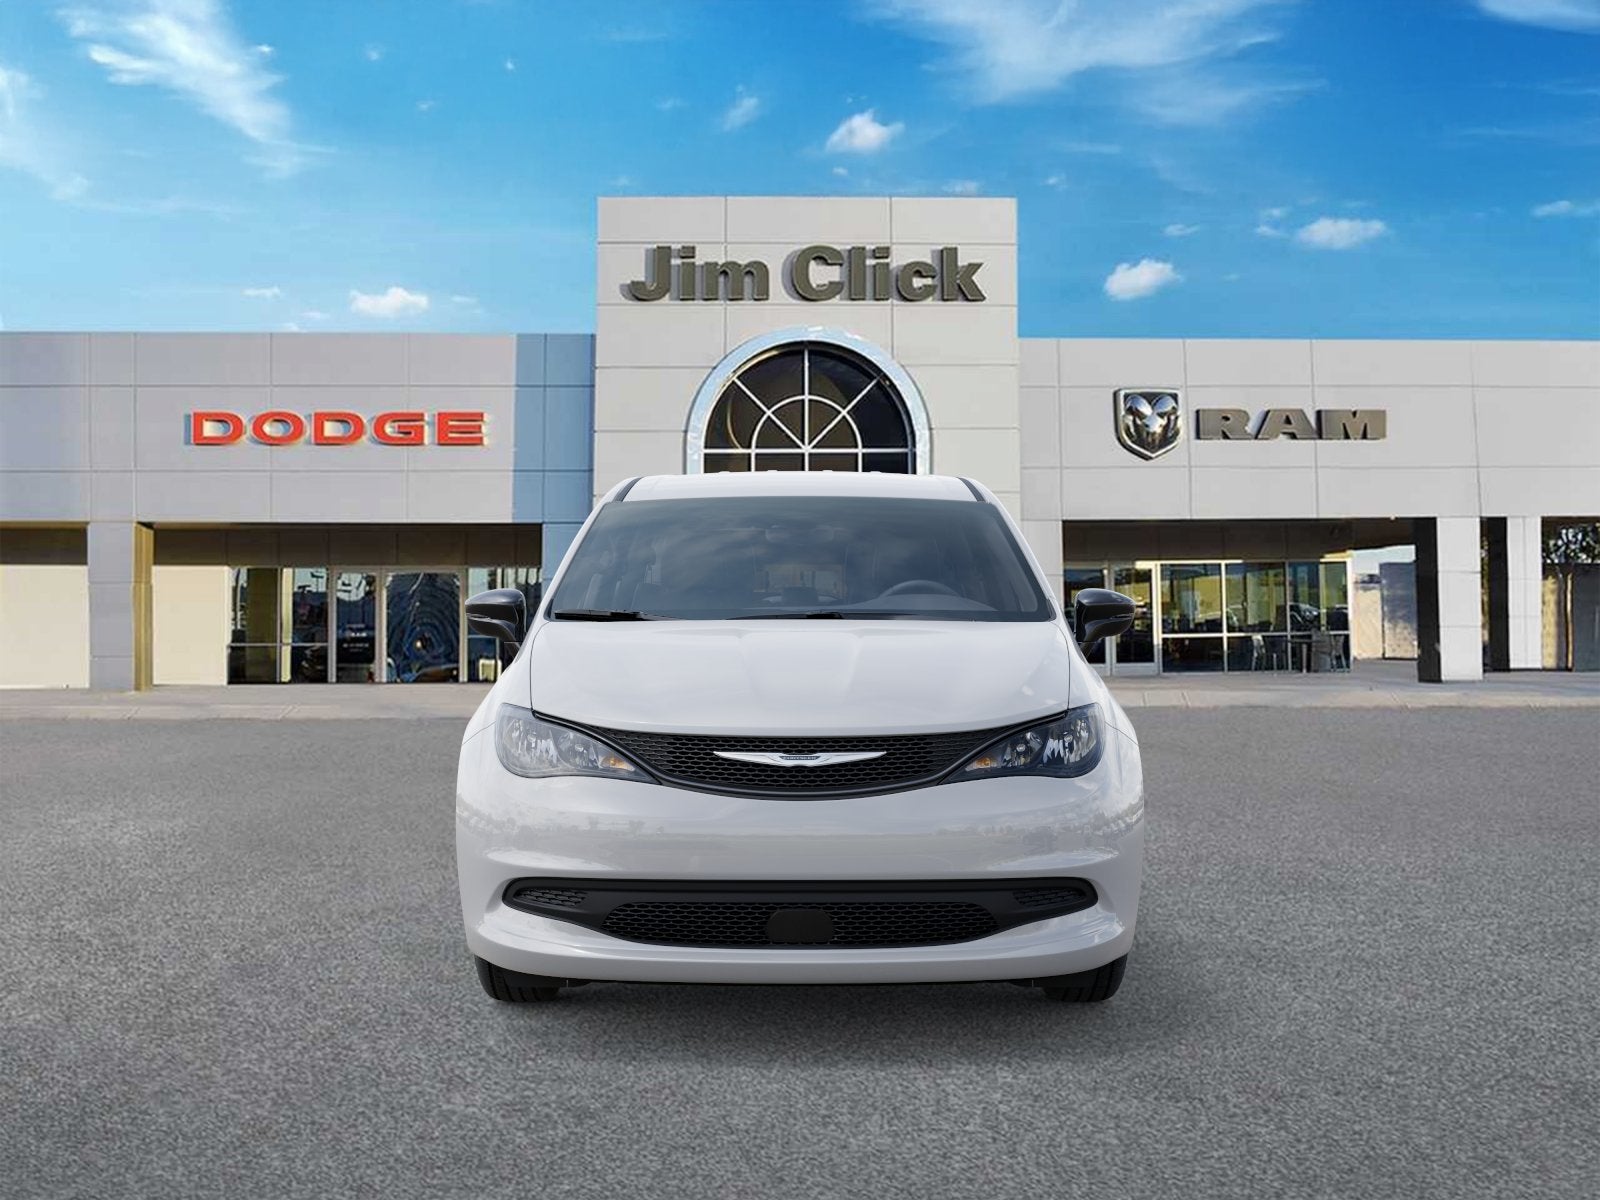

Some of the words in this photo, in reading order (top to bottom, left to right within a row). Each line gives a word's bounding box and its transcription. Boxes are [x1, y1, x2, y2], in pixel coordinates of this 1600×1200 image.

[627, 245, 769, 301] Jim
[790, 244, 986, 301] Click
[192, 411, 486, 446] DODGE
[1196, 408, 1387, 440] RAM
